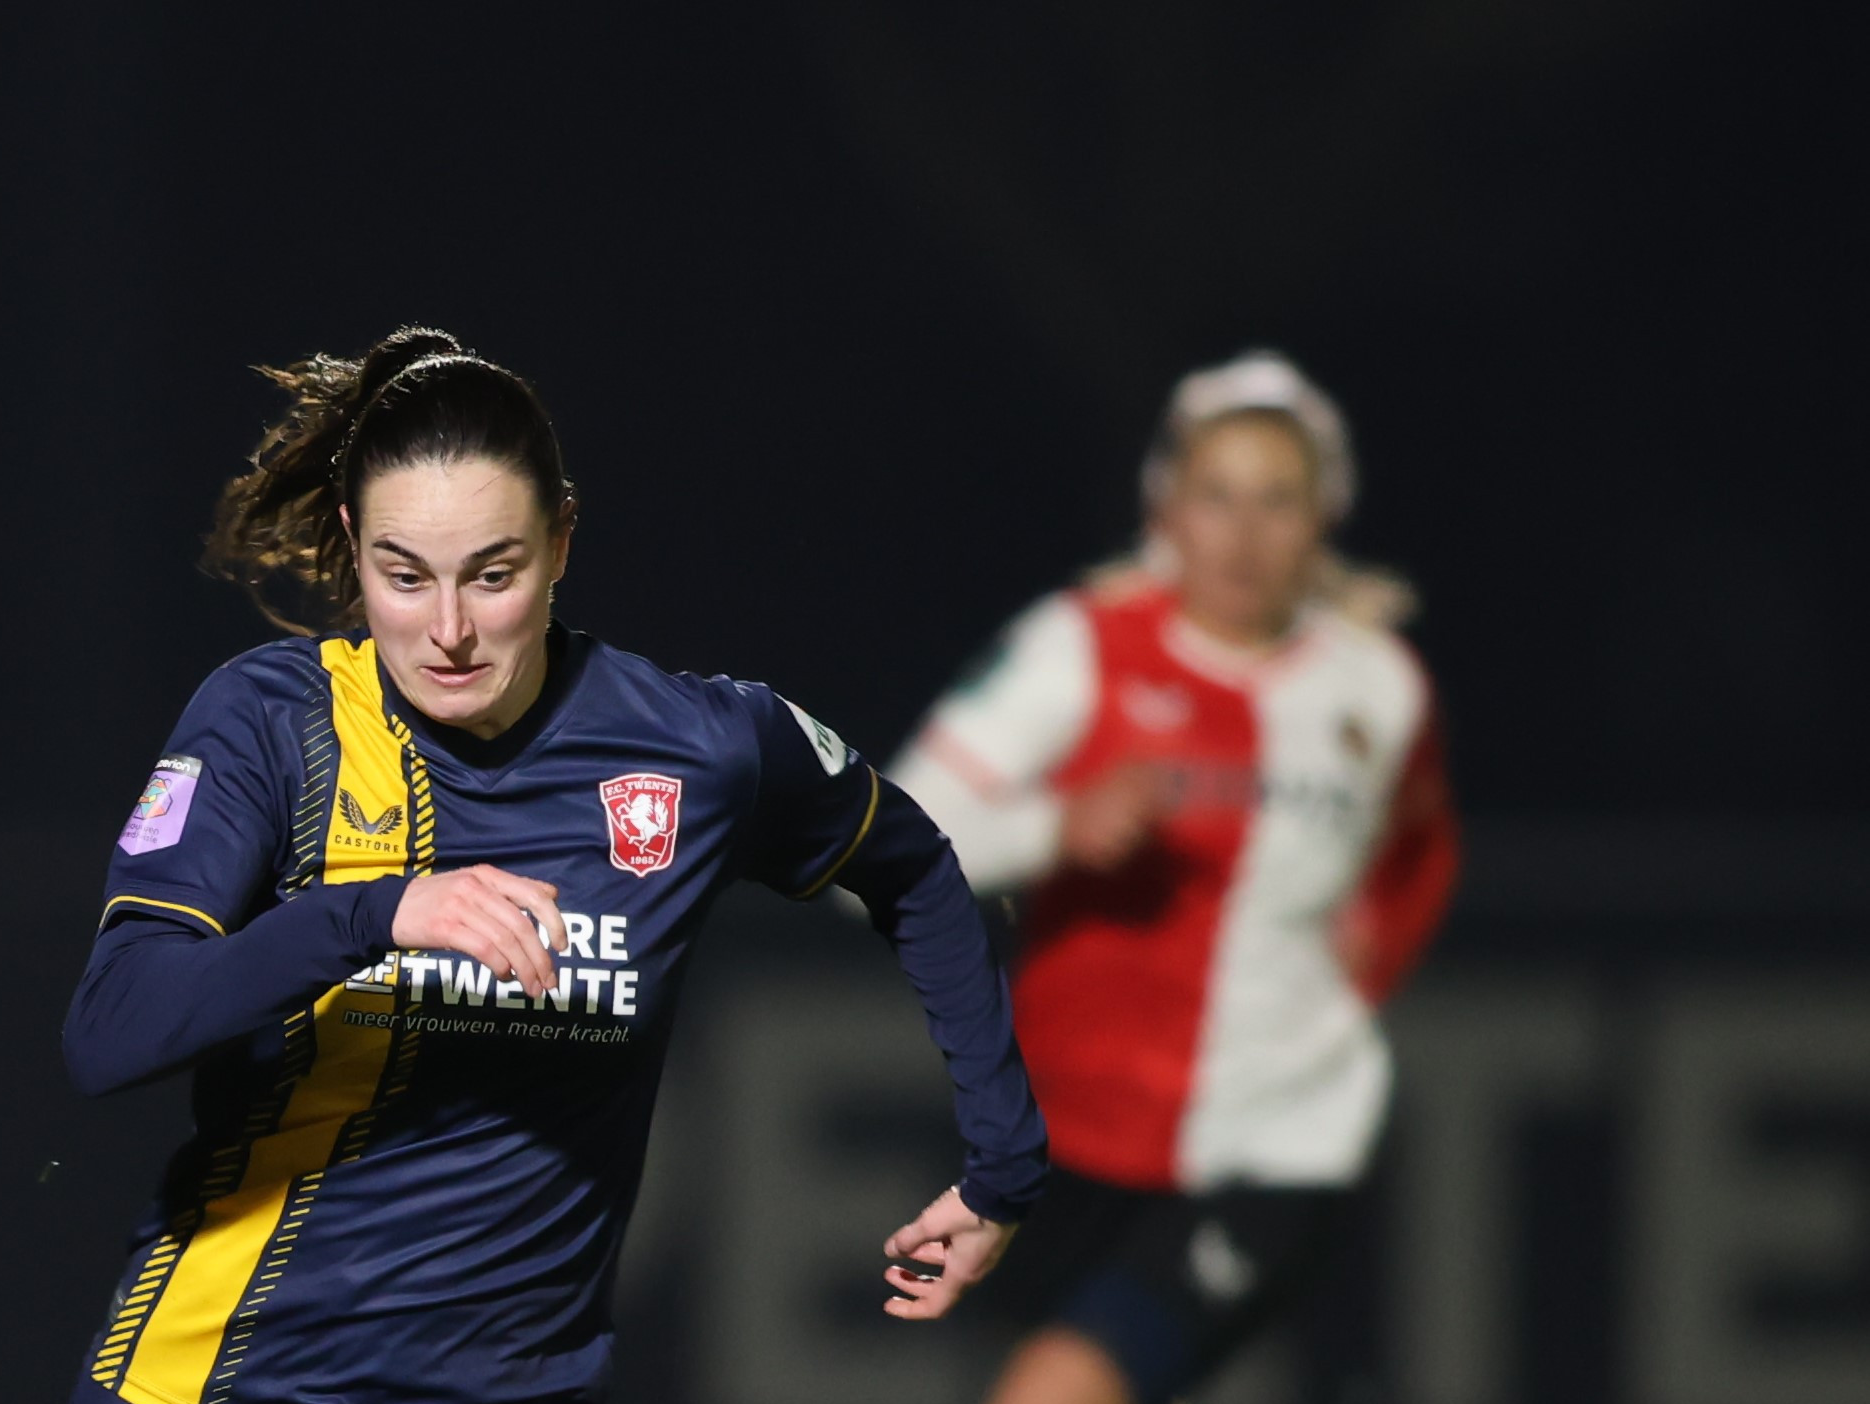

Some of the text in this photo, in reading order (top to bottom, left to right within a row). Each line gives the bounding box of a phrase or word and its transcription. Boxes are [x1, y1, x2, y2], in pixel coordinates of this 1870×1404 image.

[626, 781, 676, 794] TWENTE
[335, 834, 400, 854] CASTORE
[630, 855, 655, 865] 1965
[344, 1009, 400, 1029] meer
[508, 1021, 565, 1040] meer
